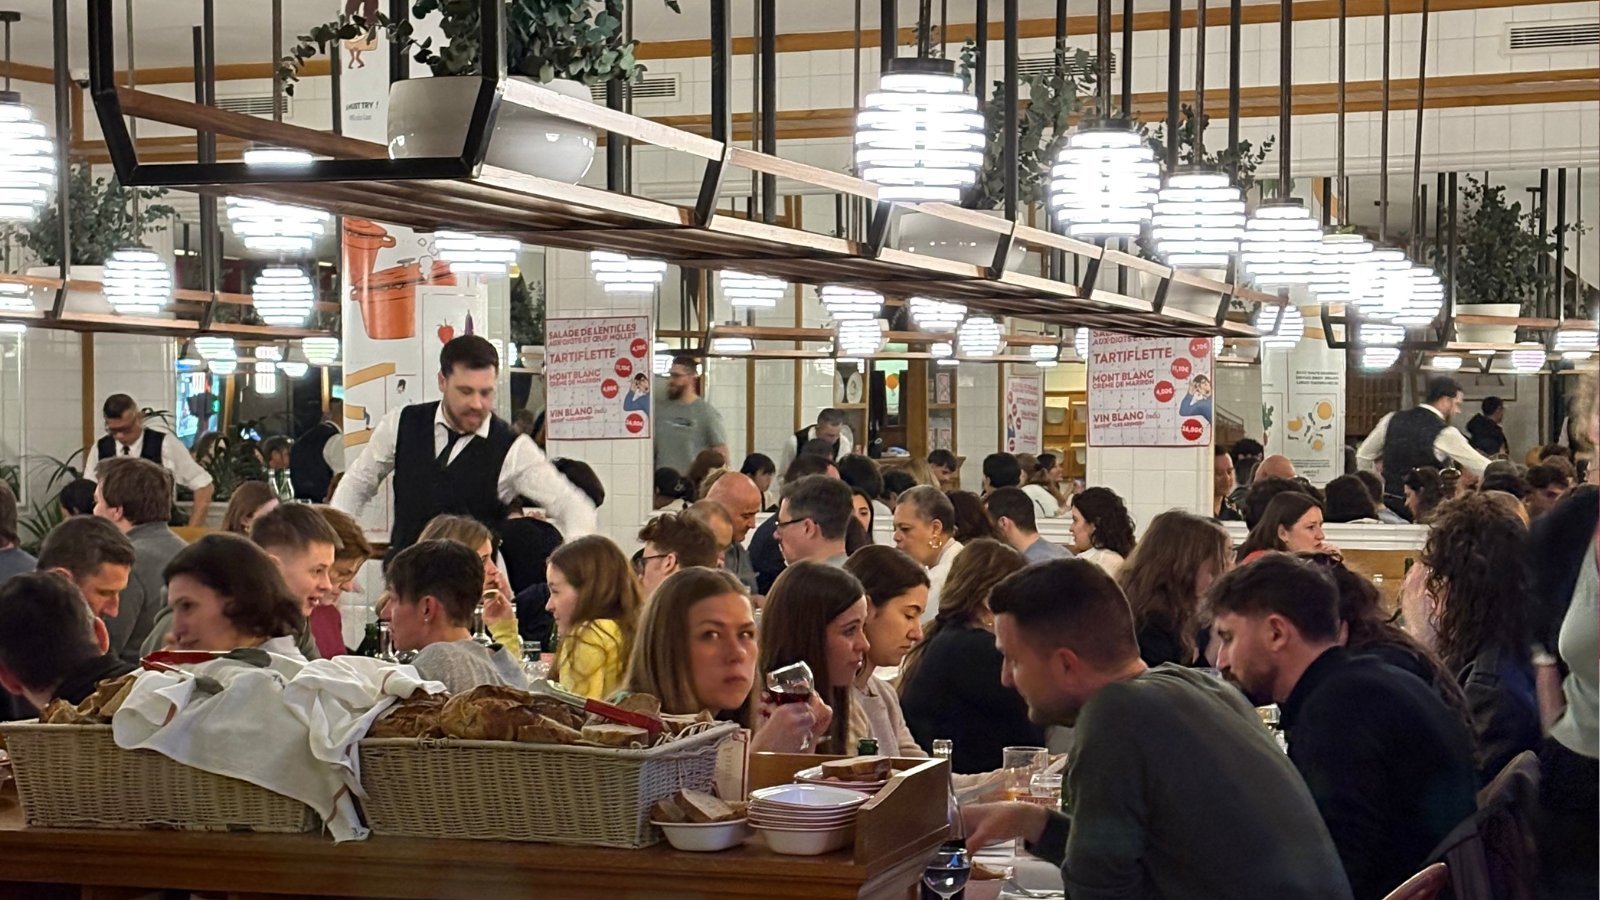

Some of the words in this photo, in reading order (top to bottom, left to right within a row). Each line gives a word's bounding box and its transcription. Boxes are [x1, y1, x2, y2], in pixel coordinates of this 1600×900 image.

[548, 328, 579, 339] SALADE
[581, 327, 593, 336] DE
[549, 348, 616, 364] TARTIFLETTE
[1093, 347, 1172, 364] TARTIFLETTE
[549, 371, 573, 381] MONT
[573, 368, 602, 379] BLANC
[1092, 373, 1120, 383] MONT
[1121, 370, 1154, 381] BLANC
[1125, 379, 1154, 387] MARRON
[550, 409, 564, 418] VIN
[565, 407, 593, 416] BLANC
[1093, 413, 1110, 423] VIN
[1111, 411, 1144, 422] BLANC
